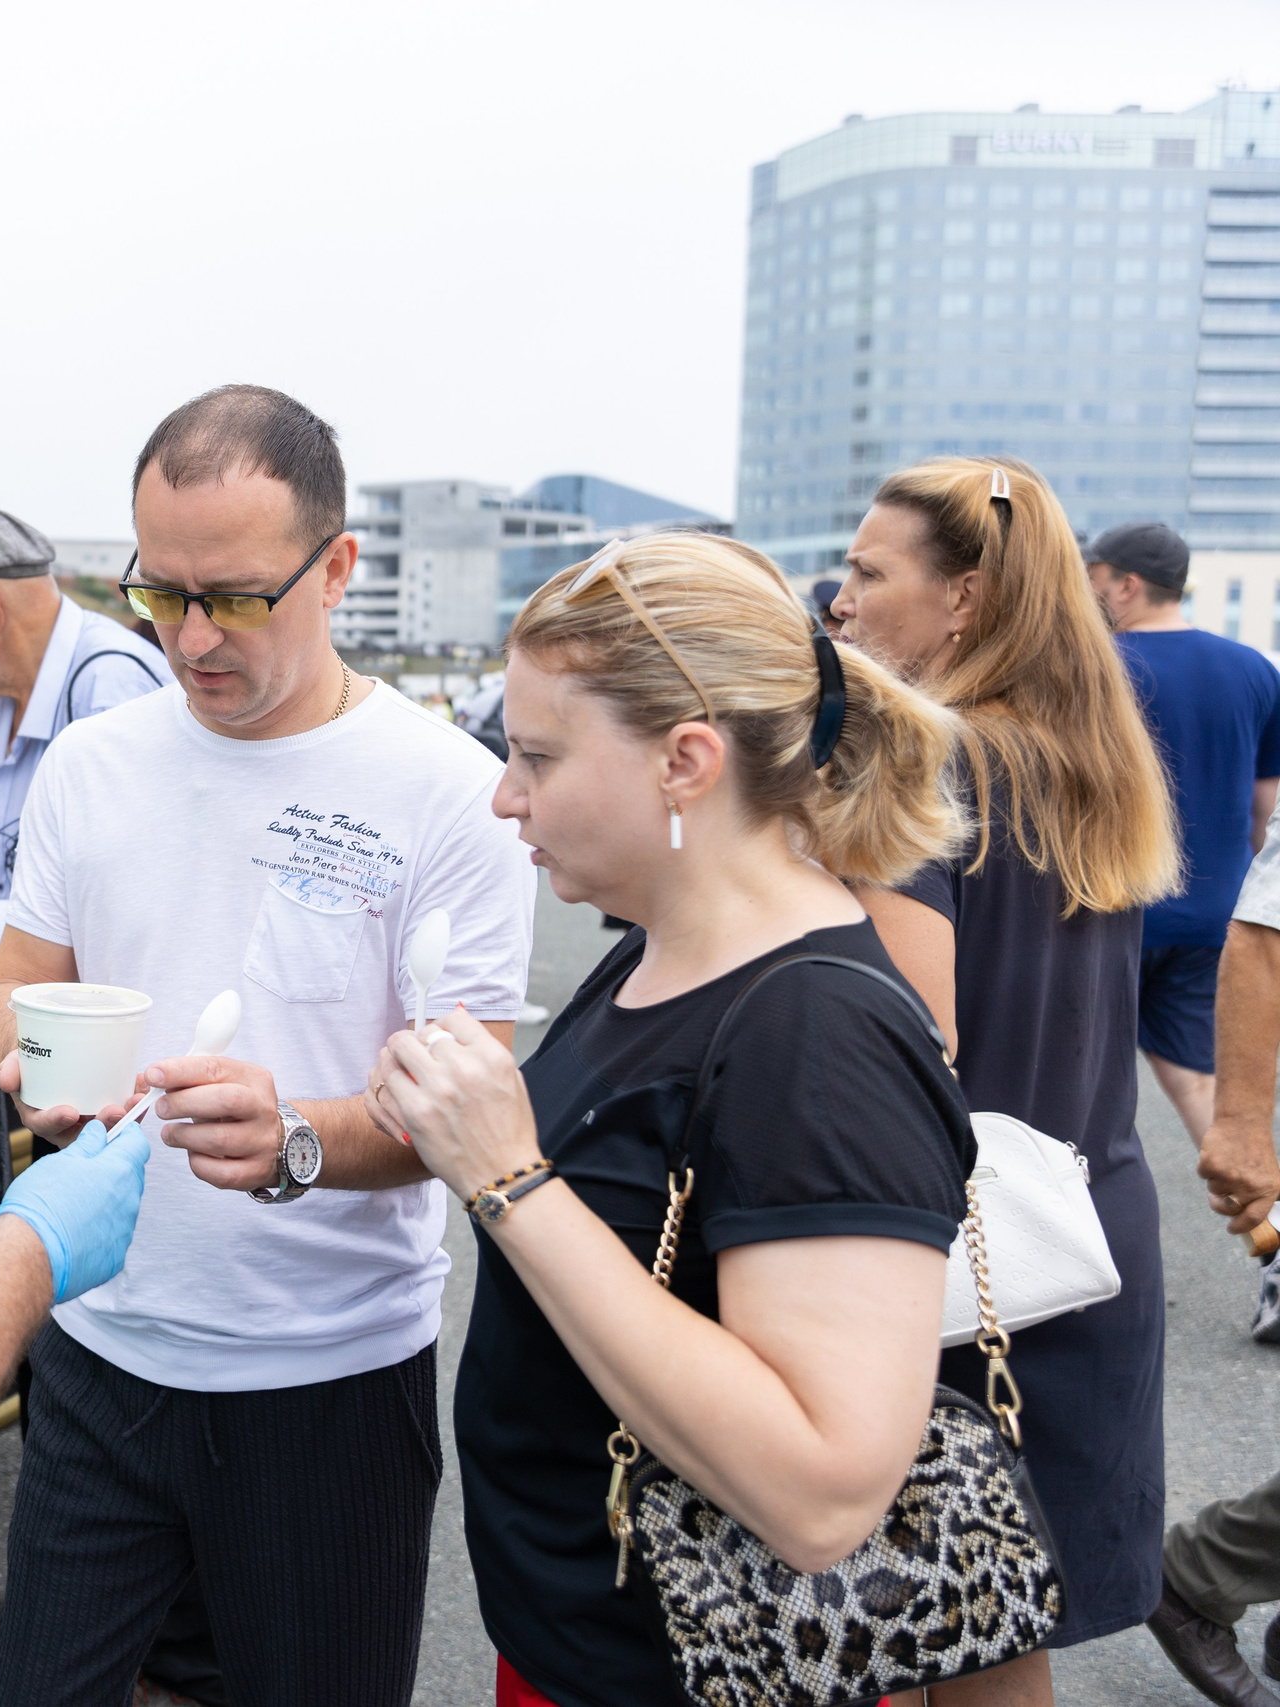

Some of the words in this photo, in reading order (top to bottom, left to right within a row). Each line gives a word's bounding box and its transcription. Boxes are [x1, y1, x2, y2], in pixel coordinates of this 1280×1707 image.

[282, 803, 325, 822] Active
[329, 814, 381, 840] Fashion
[266, 821, 302, 842] Quality
[305, 828, 344, 848] Products
[347, 841, 374, 857] Since
[376, 851, 404, 866] 1976
[289, 851, 310, 865] Jean
[312, 856, 338, 873] Piere
[300, 843, 339, 857] EXPLORERS
[342, 854, 356, 863] FOR
[358, 859, 381, 870] STYLE
[251, 857, 268, 868] NEXT
[269, 860, 309, 876] GENERATION
[311, 871, 327, 880] RAW
[327, 875, 349, 887] SERIES
[351, 882, 387, 899] OVERNEXS
